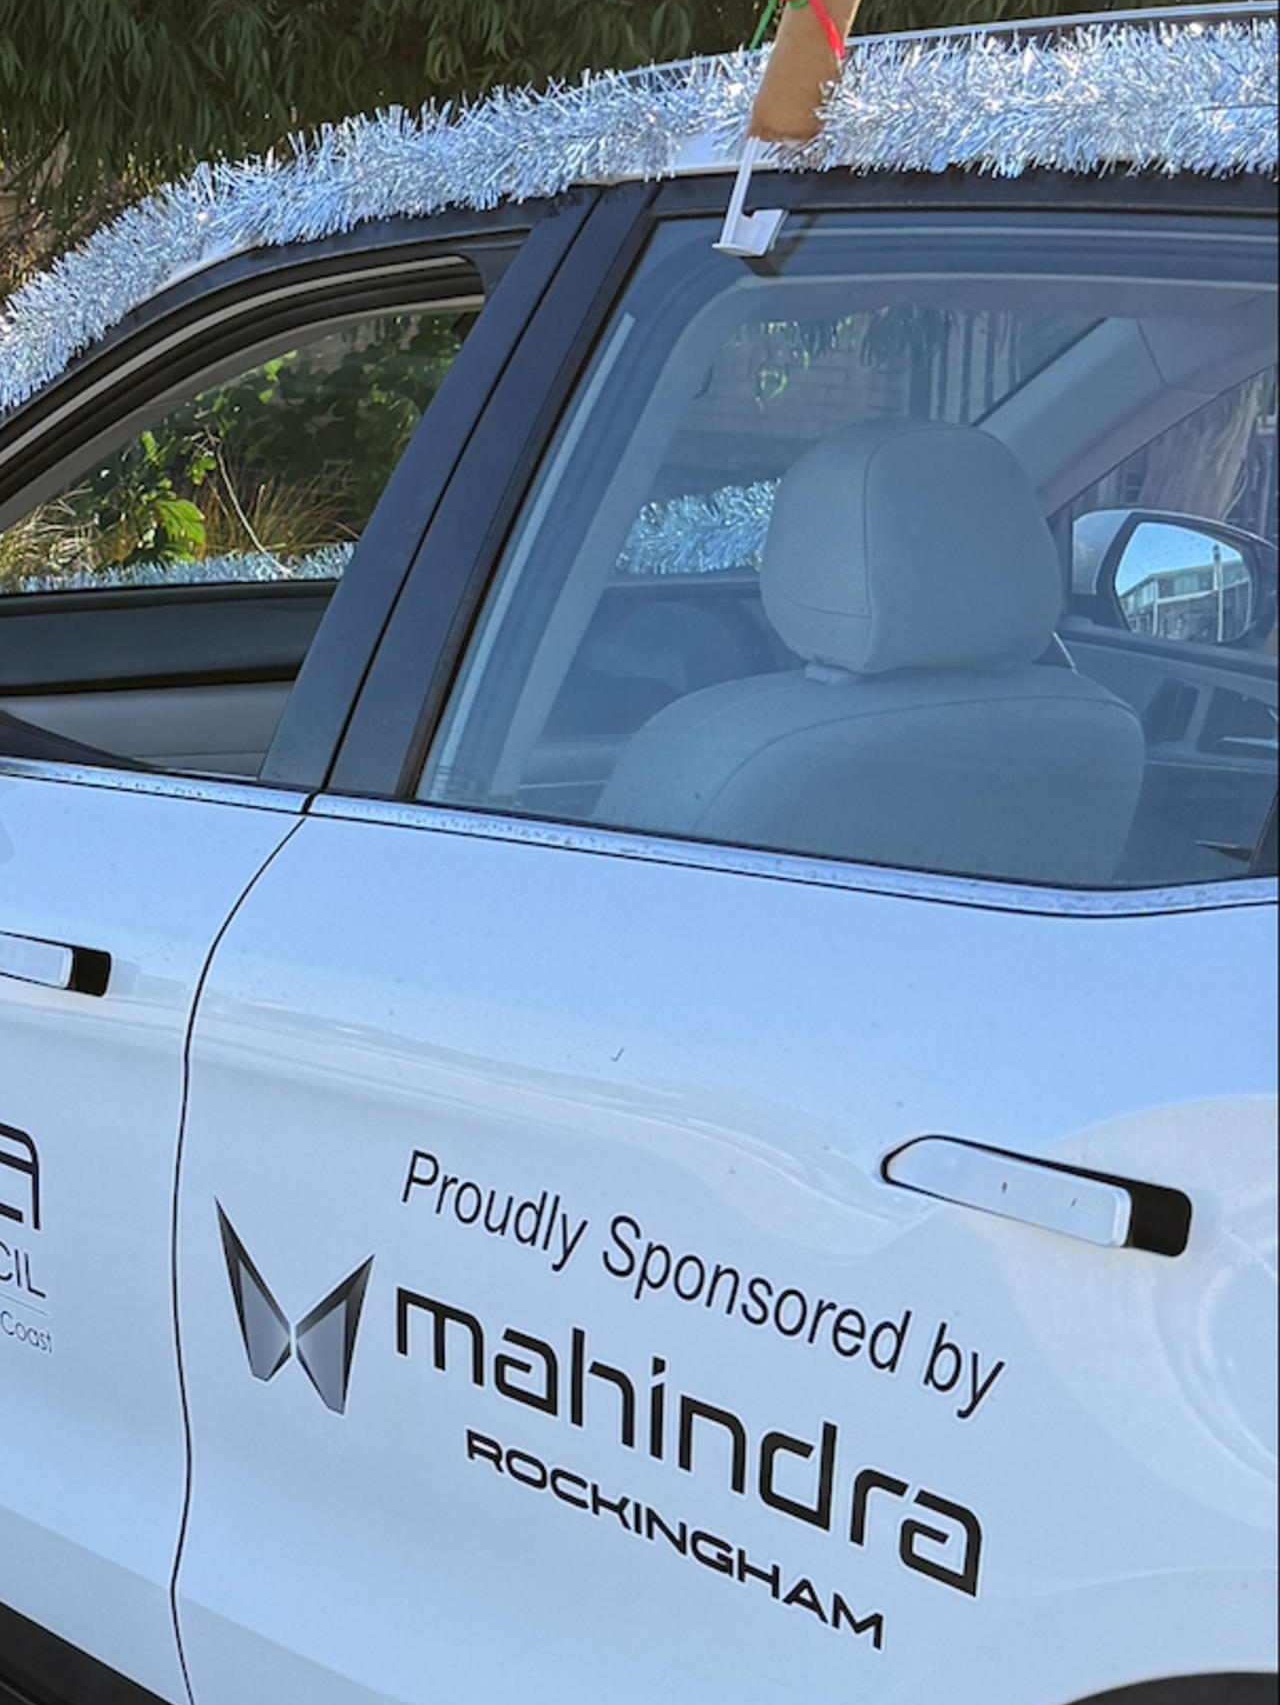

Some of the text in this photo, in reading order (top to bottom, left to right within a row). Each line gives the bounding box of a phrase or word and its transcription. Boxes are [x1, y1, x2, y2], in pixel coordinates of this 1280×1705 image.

[0, 1310, 54, 1355] Coast
[401, 1149, 1006, 1419] Proudly Sponsored by
[396, 1286, 982, 1598] mahindra
[465, 1428, 884, 1651] ROCKINGHAM
